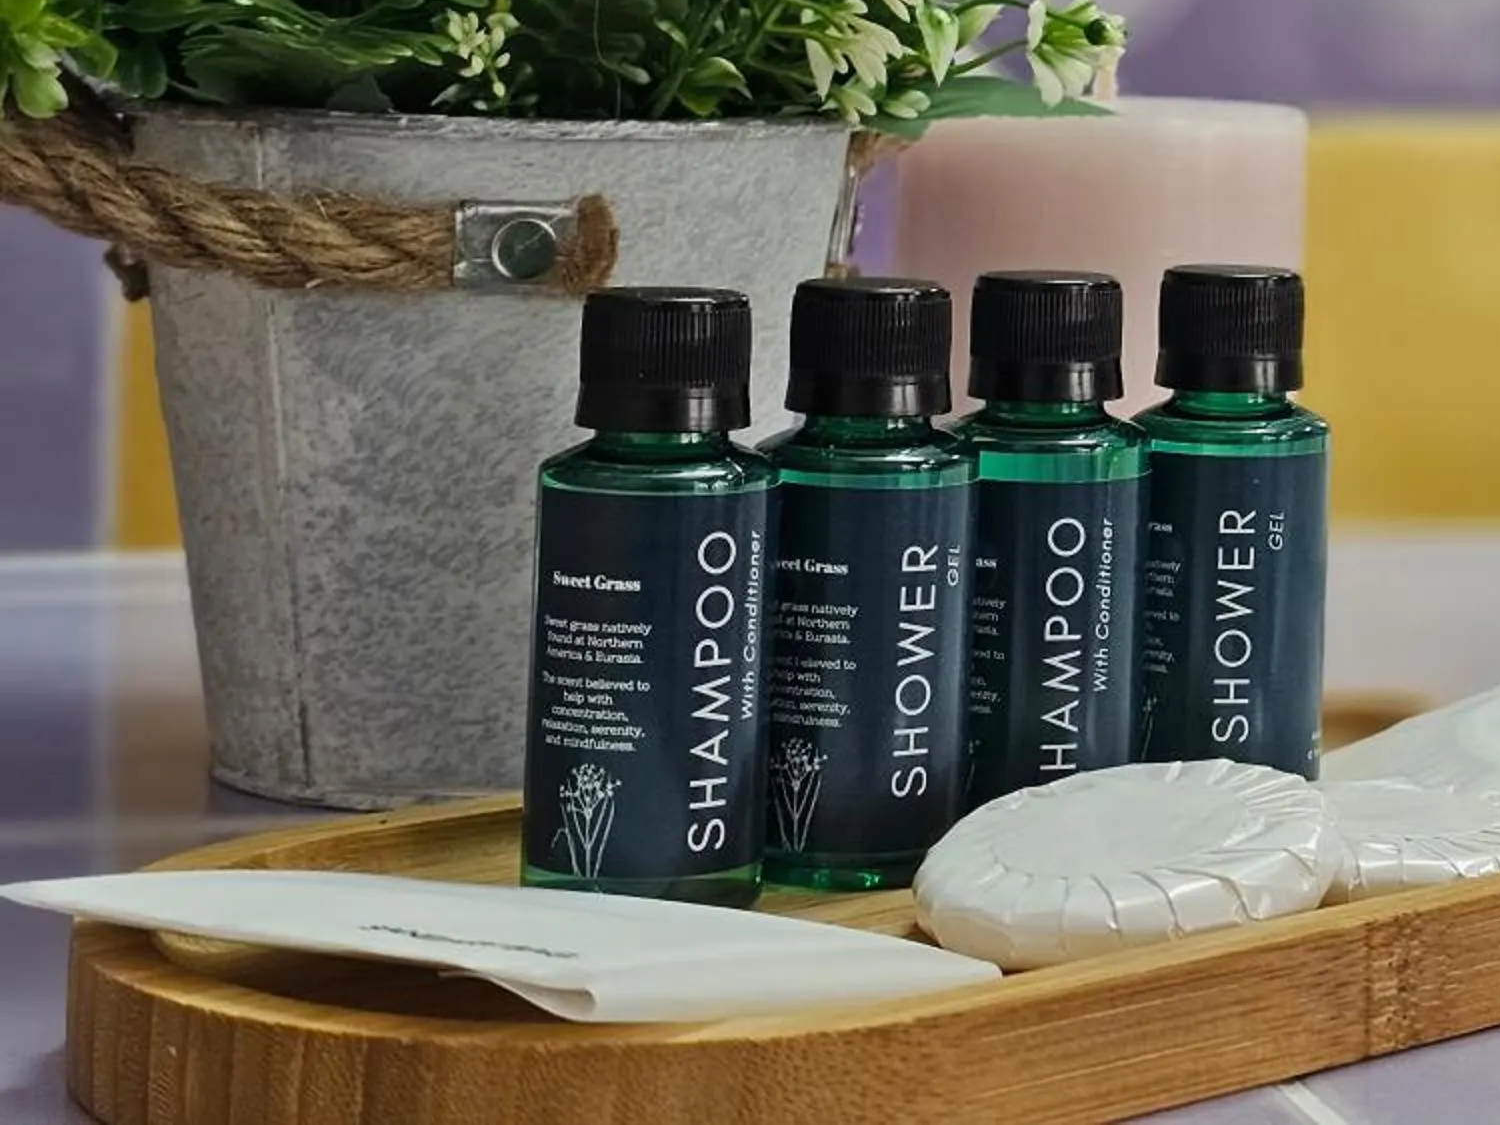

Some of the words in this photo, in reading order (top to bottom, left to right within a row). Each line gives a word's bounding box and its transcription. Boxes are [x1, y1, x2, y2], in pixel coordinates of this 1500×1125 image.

[1268, 511, 1286, 551] GEL
[803, 559, 849, 575] Grass
[947, 544, 961, 587] GEL
[975, 558, 998, 569] ass
[553, 571, 591, 589] Sweet
[594, 575, 641, 592] Grass
[1096, 517, 1113, 640] Conditioner
[743, 530, 762, 663] Conditioner
[811, 604, 859, 617] natively
[602, 623, 653, 636] natively
[797, 616, 850, 629] Northern
[1211, 509, 1257, 743] SHOWER
[587, 635, 643, 649] Northern
[1039, 517, 1087, 771] HAMPOO
[843, 660, 857, 670] to
[891, 542, 940, 799] SHOWER
[1094, 647, 1109, 692] With
[585, 678, 634, 691] believed
[637, 680, 651, 692] to
[687, 530, 737, 852] SHAMPOO
[739, 671, 756, 720] With
[587, 693, 613, 705] with
[591, 725, 645, 738] serenity,
